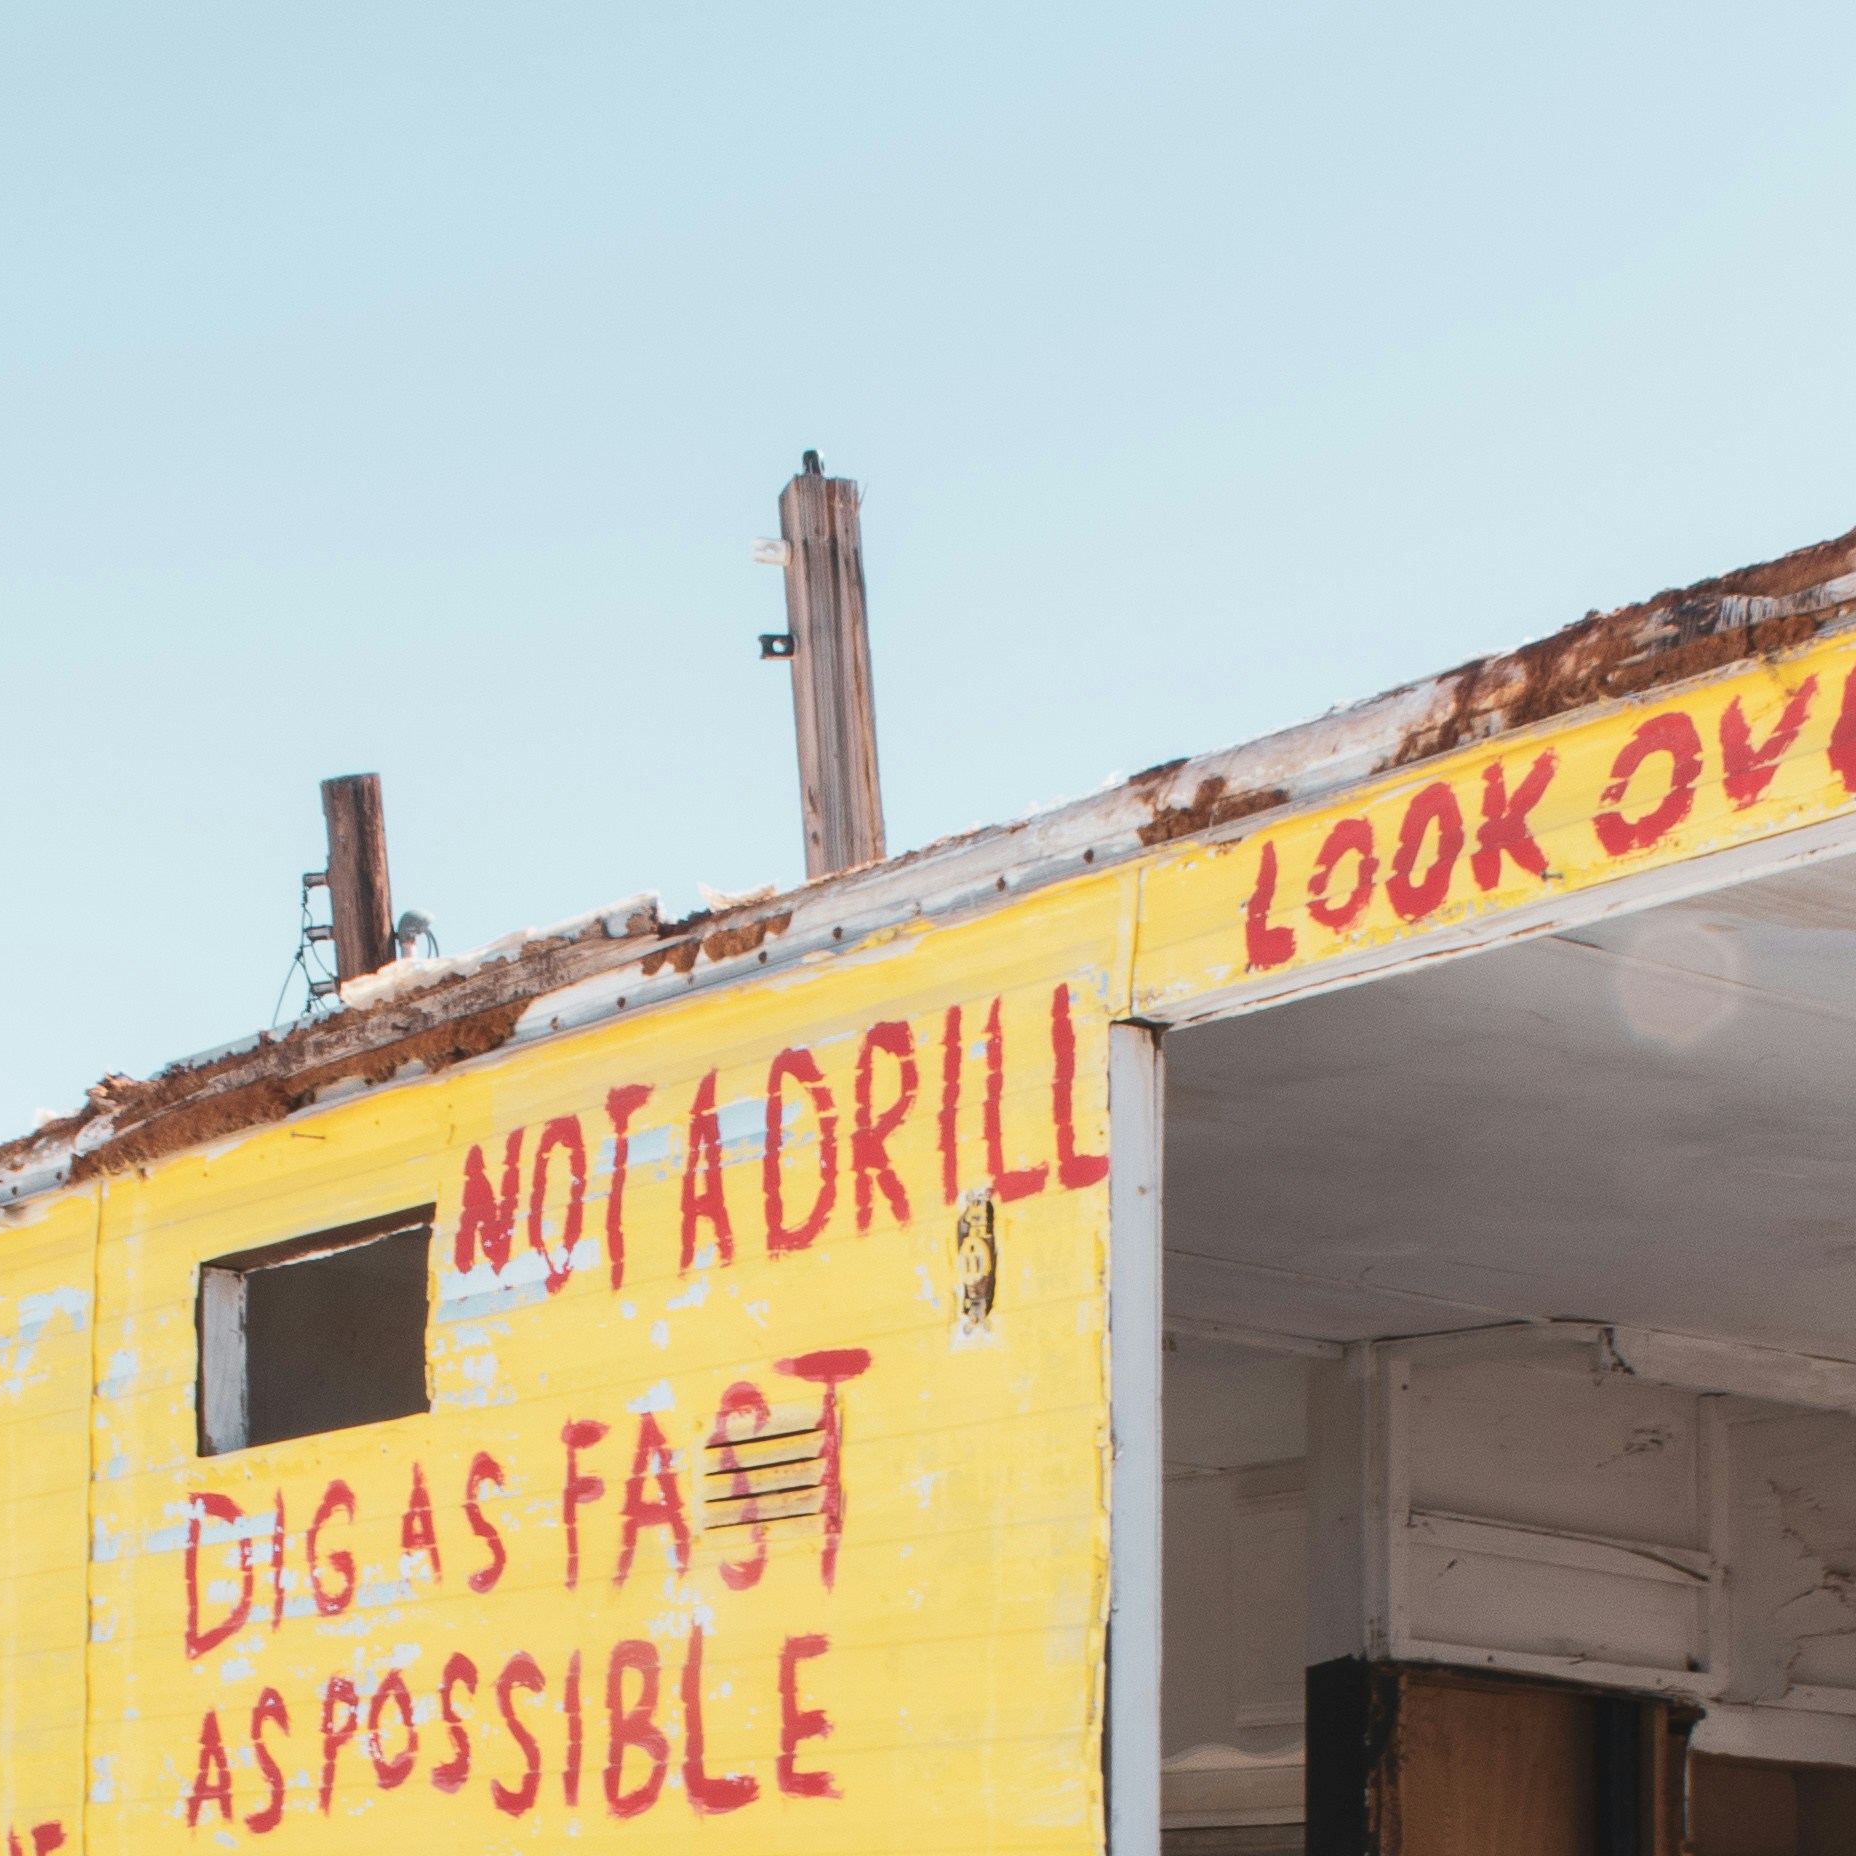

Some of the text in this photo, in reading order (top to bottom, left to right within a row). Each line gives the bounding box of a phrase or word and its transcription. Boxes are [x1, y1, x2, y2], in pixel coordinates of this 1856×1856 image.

[1246, 746, 1549, 974] LOOK
[451, 983, 1111, 1292] NOT A DRILL
[181, 1346, 873, 1662] DIG AS FAST
[184, 1620, 845, 1836] AS POSSIBLE
